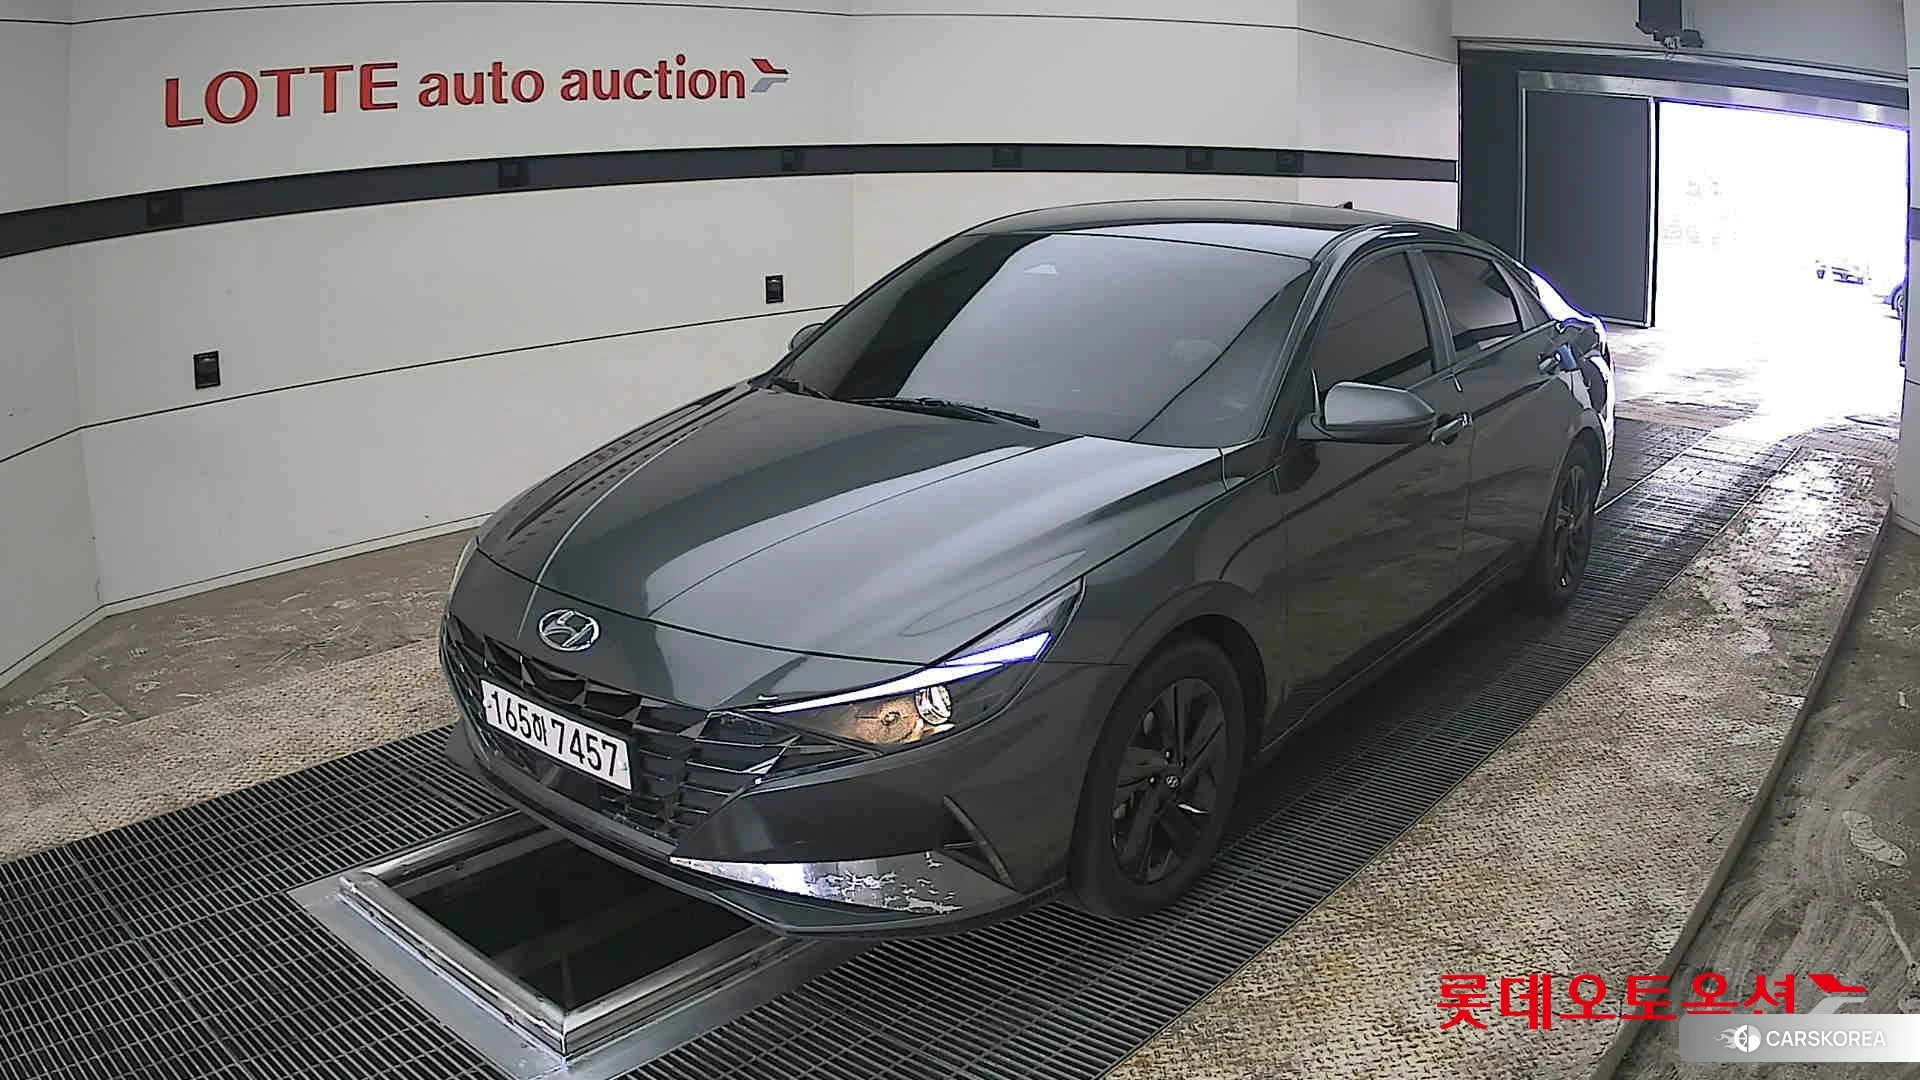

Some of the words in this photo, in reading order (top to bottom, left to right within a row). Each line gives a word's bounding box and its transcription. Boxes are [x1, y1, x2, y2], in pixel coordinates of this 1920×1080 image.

[164, 61, 399, 129] LOTTE
[418, 61, 545, 107] auto
[560, 54, 747, 101] auction
[551, 719, 618, 777] 7457
